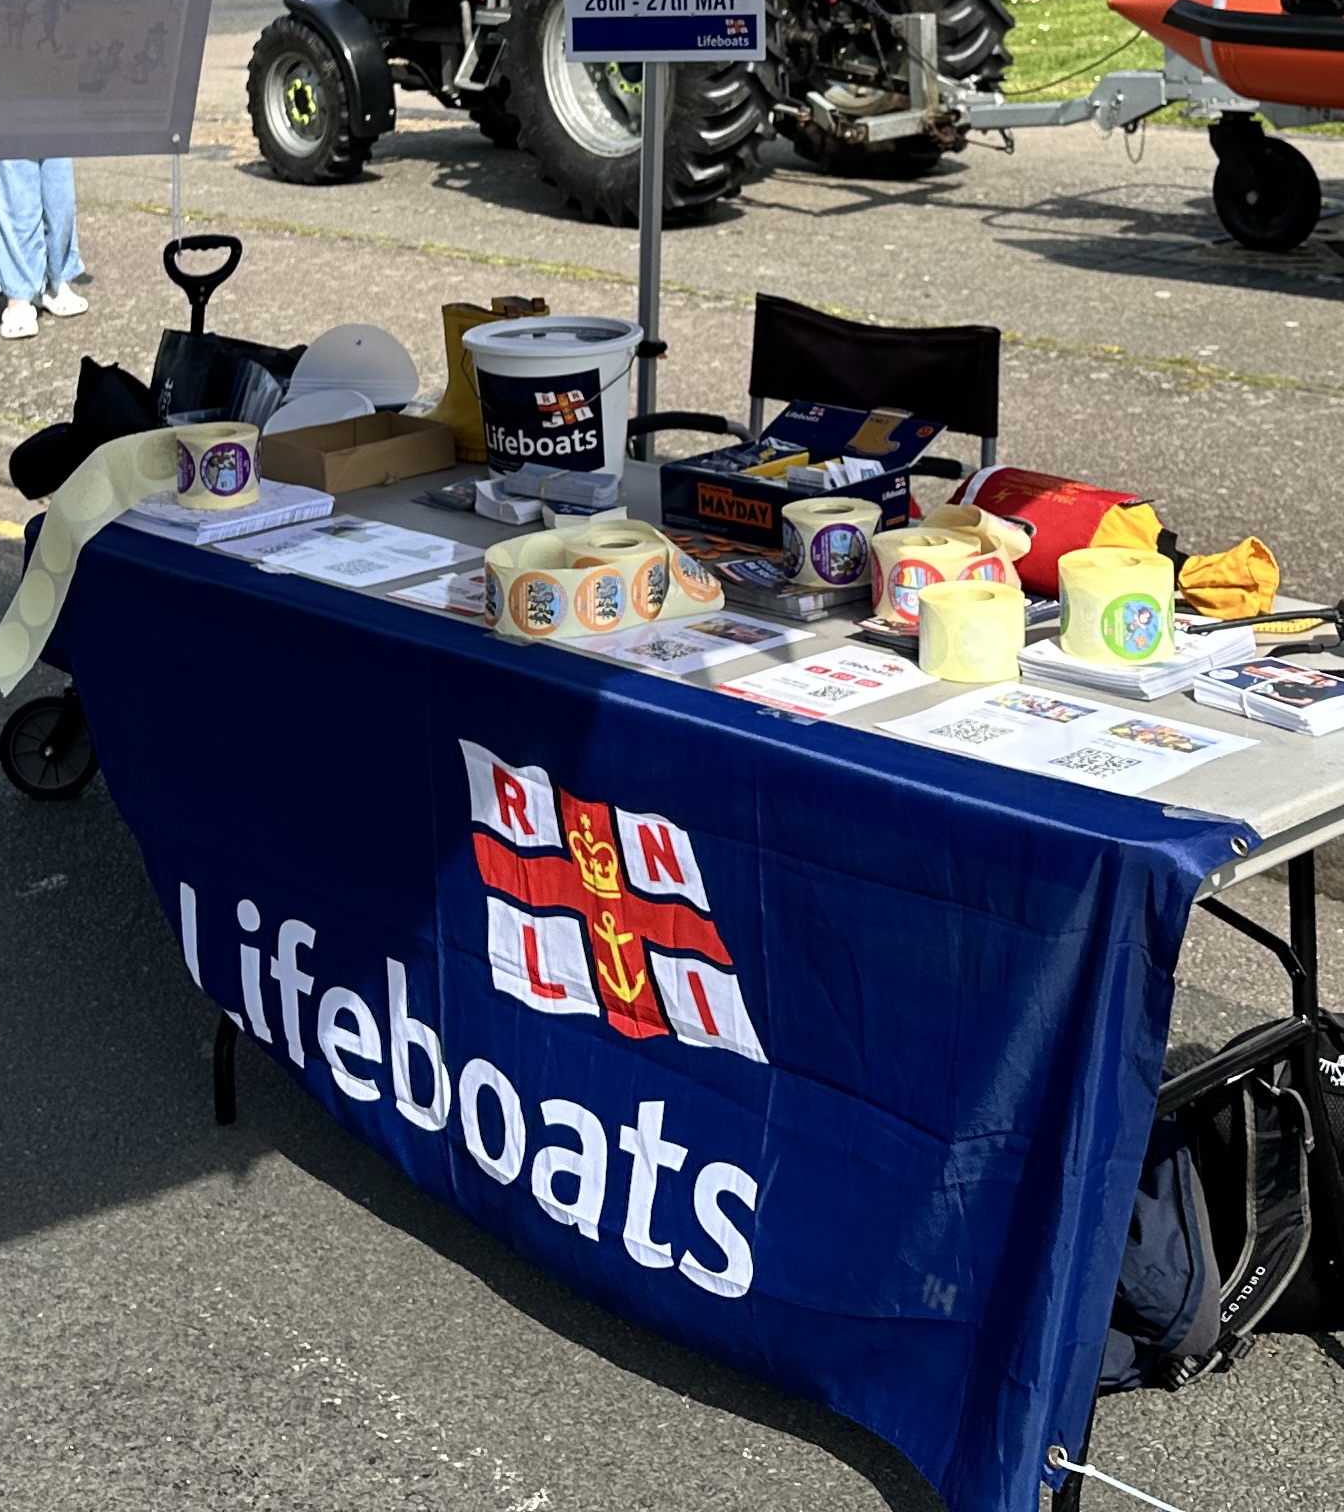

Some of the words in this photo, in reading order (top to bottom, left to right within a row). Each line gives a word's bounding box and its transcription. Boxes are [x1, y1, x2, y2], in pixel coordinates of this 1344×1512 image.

[696, 35, 750, 48] Lifeboats
[485, 422, 598, 456] Lifeboats
[701, 492, 770, 524] MAYDAY
[492, 763, 536, 835] R
[639, 824, 686, 885] N
[523, 925, 566, 999] L
[687, 971, 719, 1036] I
[180, 880, 757, 1298] Lifeboats
